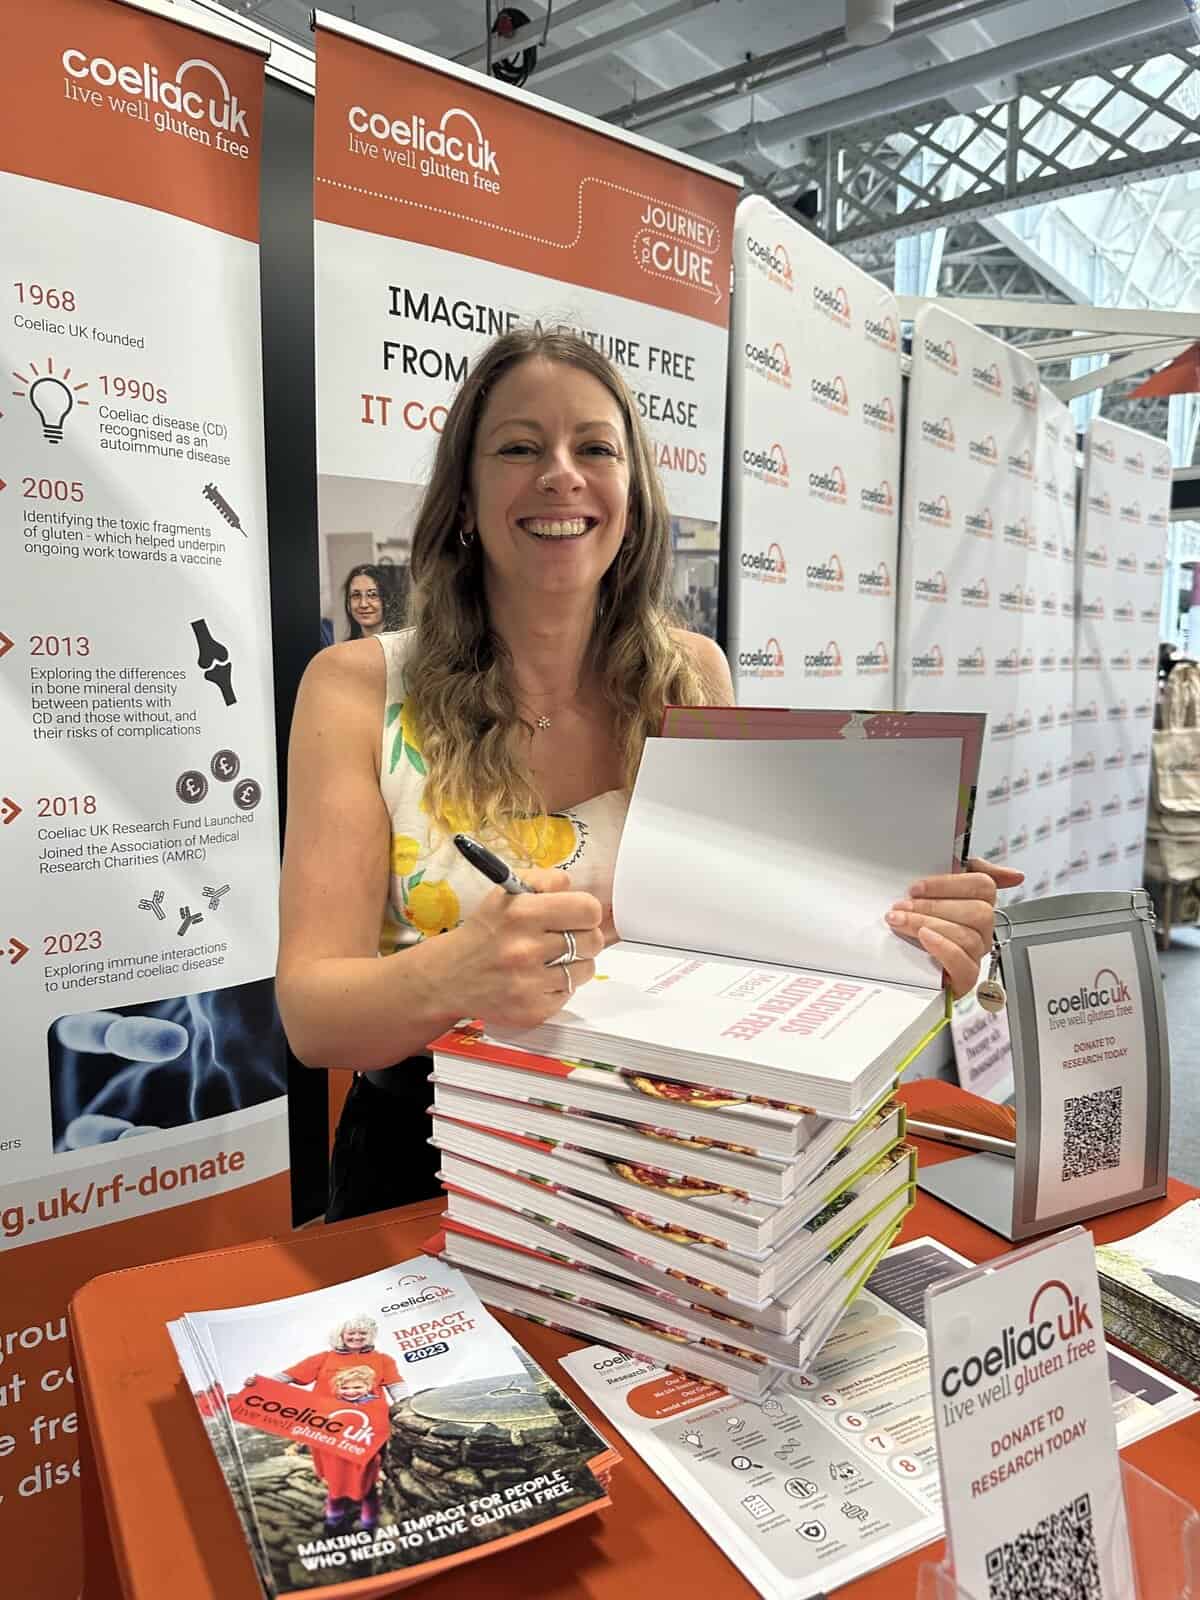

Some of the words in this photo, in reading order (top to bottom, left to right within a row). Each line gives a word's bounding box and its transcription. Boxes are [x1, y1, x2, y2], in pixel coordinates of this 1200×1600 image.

[62, 49, 205, 119] coeliac
[209, 95, 249, 137] uk
[64, 78, 104, 107] live
[108, 95, 150, 122] well
[154, 110, 211, 146] gluten
[216, 132, 249, 159] free
[348, 106, 464, 161] coeliac
[468, 140, 500, 176] uk
[348, 132, 378, 158] live
[382, 147, 416, 169] well
[420, 157, 469, 184] gluten
[474, 171, 500, 194] free
[641, 204, 714, 247] JOURNEY
[652, 241, 713, 287] CURE
[14, 282, 76, 312] 1968
[14, 314, 65, 335] Coeliac
[69, 324, 89, 340] UK
[92, 328, 145, 349] founded
[649, 347, 695, 381] FREE
[99, 375, 168, 404] 1990s
[383, 341, 468, 382] FROM
[631, 391, 698, 428] SEASE
[99, 406, 149, 424] Coeliac
[152, 414, 200, 432] disease
[202, 422, 228, 440] (CD)
[361, 394, 392, 426] IT
[100, 423, 172, 442] recognised
[176, 434, 190, 445] as
[194, 438, 208, 448] an
[100, 438, 183, 458] autoimmune
[187, 448, 231, 466] disease
[22, 477, 84, 502] 2005
[23, 510, 93, 529] Identifying
[97, 517, 117, 529] the
[120, 519, 150, 532] toxic
[153, 520, 211, 537] fragments
[24, 525, 38, 538] of
[42, 527, 83, 541] gluten
[94, 531, 132, 545] which
[136, 533, 175, 551] helped
[178, 538, 225, 553] underpin
[24, 543, 79, 558] ongoing
[83, 546, 114, 559] work
[118, 548, 167, 561] towards
[170, 554, 177, 562] a
[180, 553, 222, 566] vaccine
[30, 636, 89, 656] 2013
[31, 667, 92, 681] Exploring
[96, 668, 116, 680] the
[119, 668, 186, 680] differences
[31, 684, 42, 694] in
[47, 683, 80, 694] bone
[84, 683, 130, 694] mineral
[134, 682, 177, 696] density
[32, 698, 88, 709] between
[92, 697, 143, 711] patients
[146, 697, 171, 708] with
[33, 712, 52, 724] CD
[56, 712, 81, 723] and
[85, 711, 120, 722] those
[176, 710, 196, 721] and
[33, 727, 62, 740] their
[67, 726, 97, 738] risks
[100, 726, 114, 737] of
[117, 725, 201, 738] complications
[37, 795, 97, 817] 2018
[38, 827, 86, 841] Coeliac
[90, 825, 108, 836] UK
[113, 820, 169, 834] Research
[173, 817, 201, 829] Fund
[205, 813, 254, 827] Launched
[39, 846, 83, 860] Joined
[87, 844, 107, 856] the
[110, 838, 182, 854] Association
[186, 836, 196, 847] of
[200, 831, 239, 844] Medical
[40, 858, 100, 874] Research
[104, 853, 159, 868] Charities
[162, 848, 206, 865] (AMRC)
[43, 930, 102, 956] 2023
[45, 960, 104, 979] Exploring
[107, 953, 158, 969] immune
[161, 941, 227, 962] interactions
[45, 980, 58, 992] to
[62, 969, 134, 990] understand
[137, 963, 178, 978] coeliac
[182, 955, 225, 971] disease
[1048, 987, 1110, 1015] coeliac
[1111, 980, 1131, 1003] uk
[1049, 1017, 1066, 1031] live
[1067, 1011, 1087, 1025] well
[1063, 1053, 1103, 1069] RESEARCH
[1104, 1047, 1128, 1060] TODAY
[1074, 1038, 1104, 1053] DONATE
[1105, 1036, 1116, 1046] TO
[0, 1138, 21, 1151] ers
[0, 1150, 245, 1238] g.uk/rf-donate
[381, 1293, 434, 1313] coeliac
[393, 1311, 465, 1340] IMPACT
[398, 1320, 475, 1351] REPORT
[407, 1344, 446, 1361] 2023
[941, 1321, 1055, 1398] coeliac
[1058, 1296, 1093, 1341] uk
[800, 1375, 814, 1386] 4
[943, 1402, 974, 1428] live
[978, 1377, 1012, 1410] well
[1014, 1353, 1064, 1393] gluten
[1068, 1338, 1096, 1366] free
[821, 1394, 837, 1406] 5
[245, 1396, 344, 1432] coeliac
[344, 1425, 375, 1446] uk
[846, 1415, 862, 1427] 6
[991, 1419, 1044, 1457] DONATE
[1047, 1405, 1064, 1423] TO
[292, 1426, 336, 1446] gluten
[338, 1440, 365, 1455] free
[870, 1436, 885, 1449] 7
[899, 1459, 916, 1472] 8
[971, 1444, 1044, 1498] RESEARCH
[1047, 1419, 1088, 1454] TODAY
[298, 1531, 372, 1557] MAKING
[374, 1524, 400, 1541] AN
[403, 1504, 467, 1534] IMPACT
[469, 1494, 502, 1512] FOR
[505, 1469, 567, 1498] PEOPLE
[301, 1552, 346, 1571] WHO
[350, 1541, 396, 1562] NEED
[399, 1533, 423, 1549] TO
[427, 1523, 468, 1542] LIVE
[471, 1497, 533, 1527] GLUTEN
[535, 1480, 574, 1504] FREE
